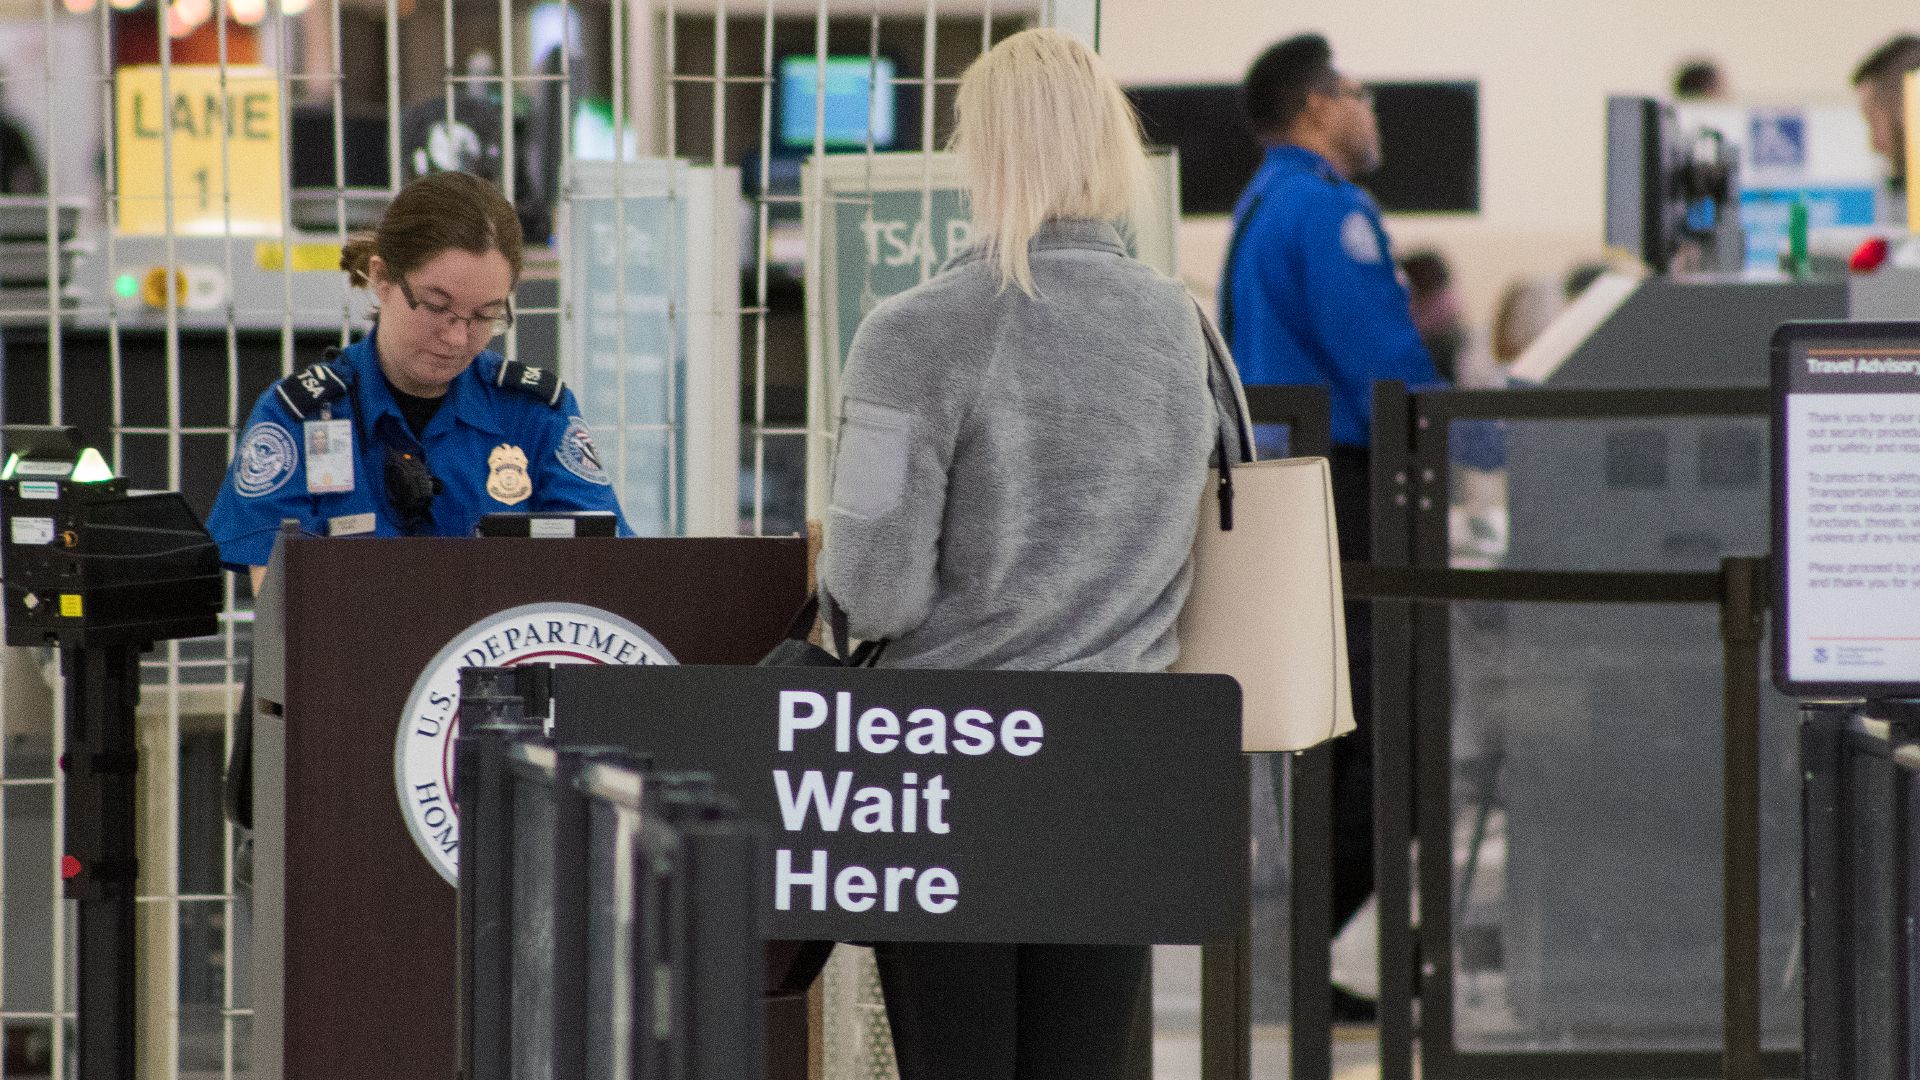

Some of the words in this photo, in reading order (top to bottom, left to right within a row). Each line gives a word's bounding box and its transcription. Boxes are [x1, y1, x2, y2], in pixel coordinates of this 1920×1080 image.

[134, 91, 272, 140] LANE
[193, 167, 209, 209] 1
[861, 221, 937, 266] TSA
[297, 368, 326, 399] TSA
[1806, 358, 1854, 374] Travel
[416, 690, 457, 738] U.S.
[777, 690, 1044, 756] Please
[415, 782, 459, 866] HOM
[772, 770, 950, 834] Wait
[774, 849, 959, 914] Here
